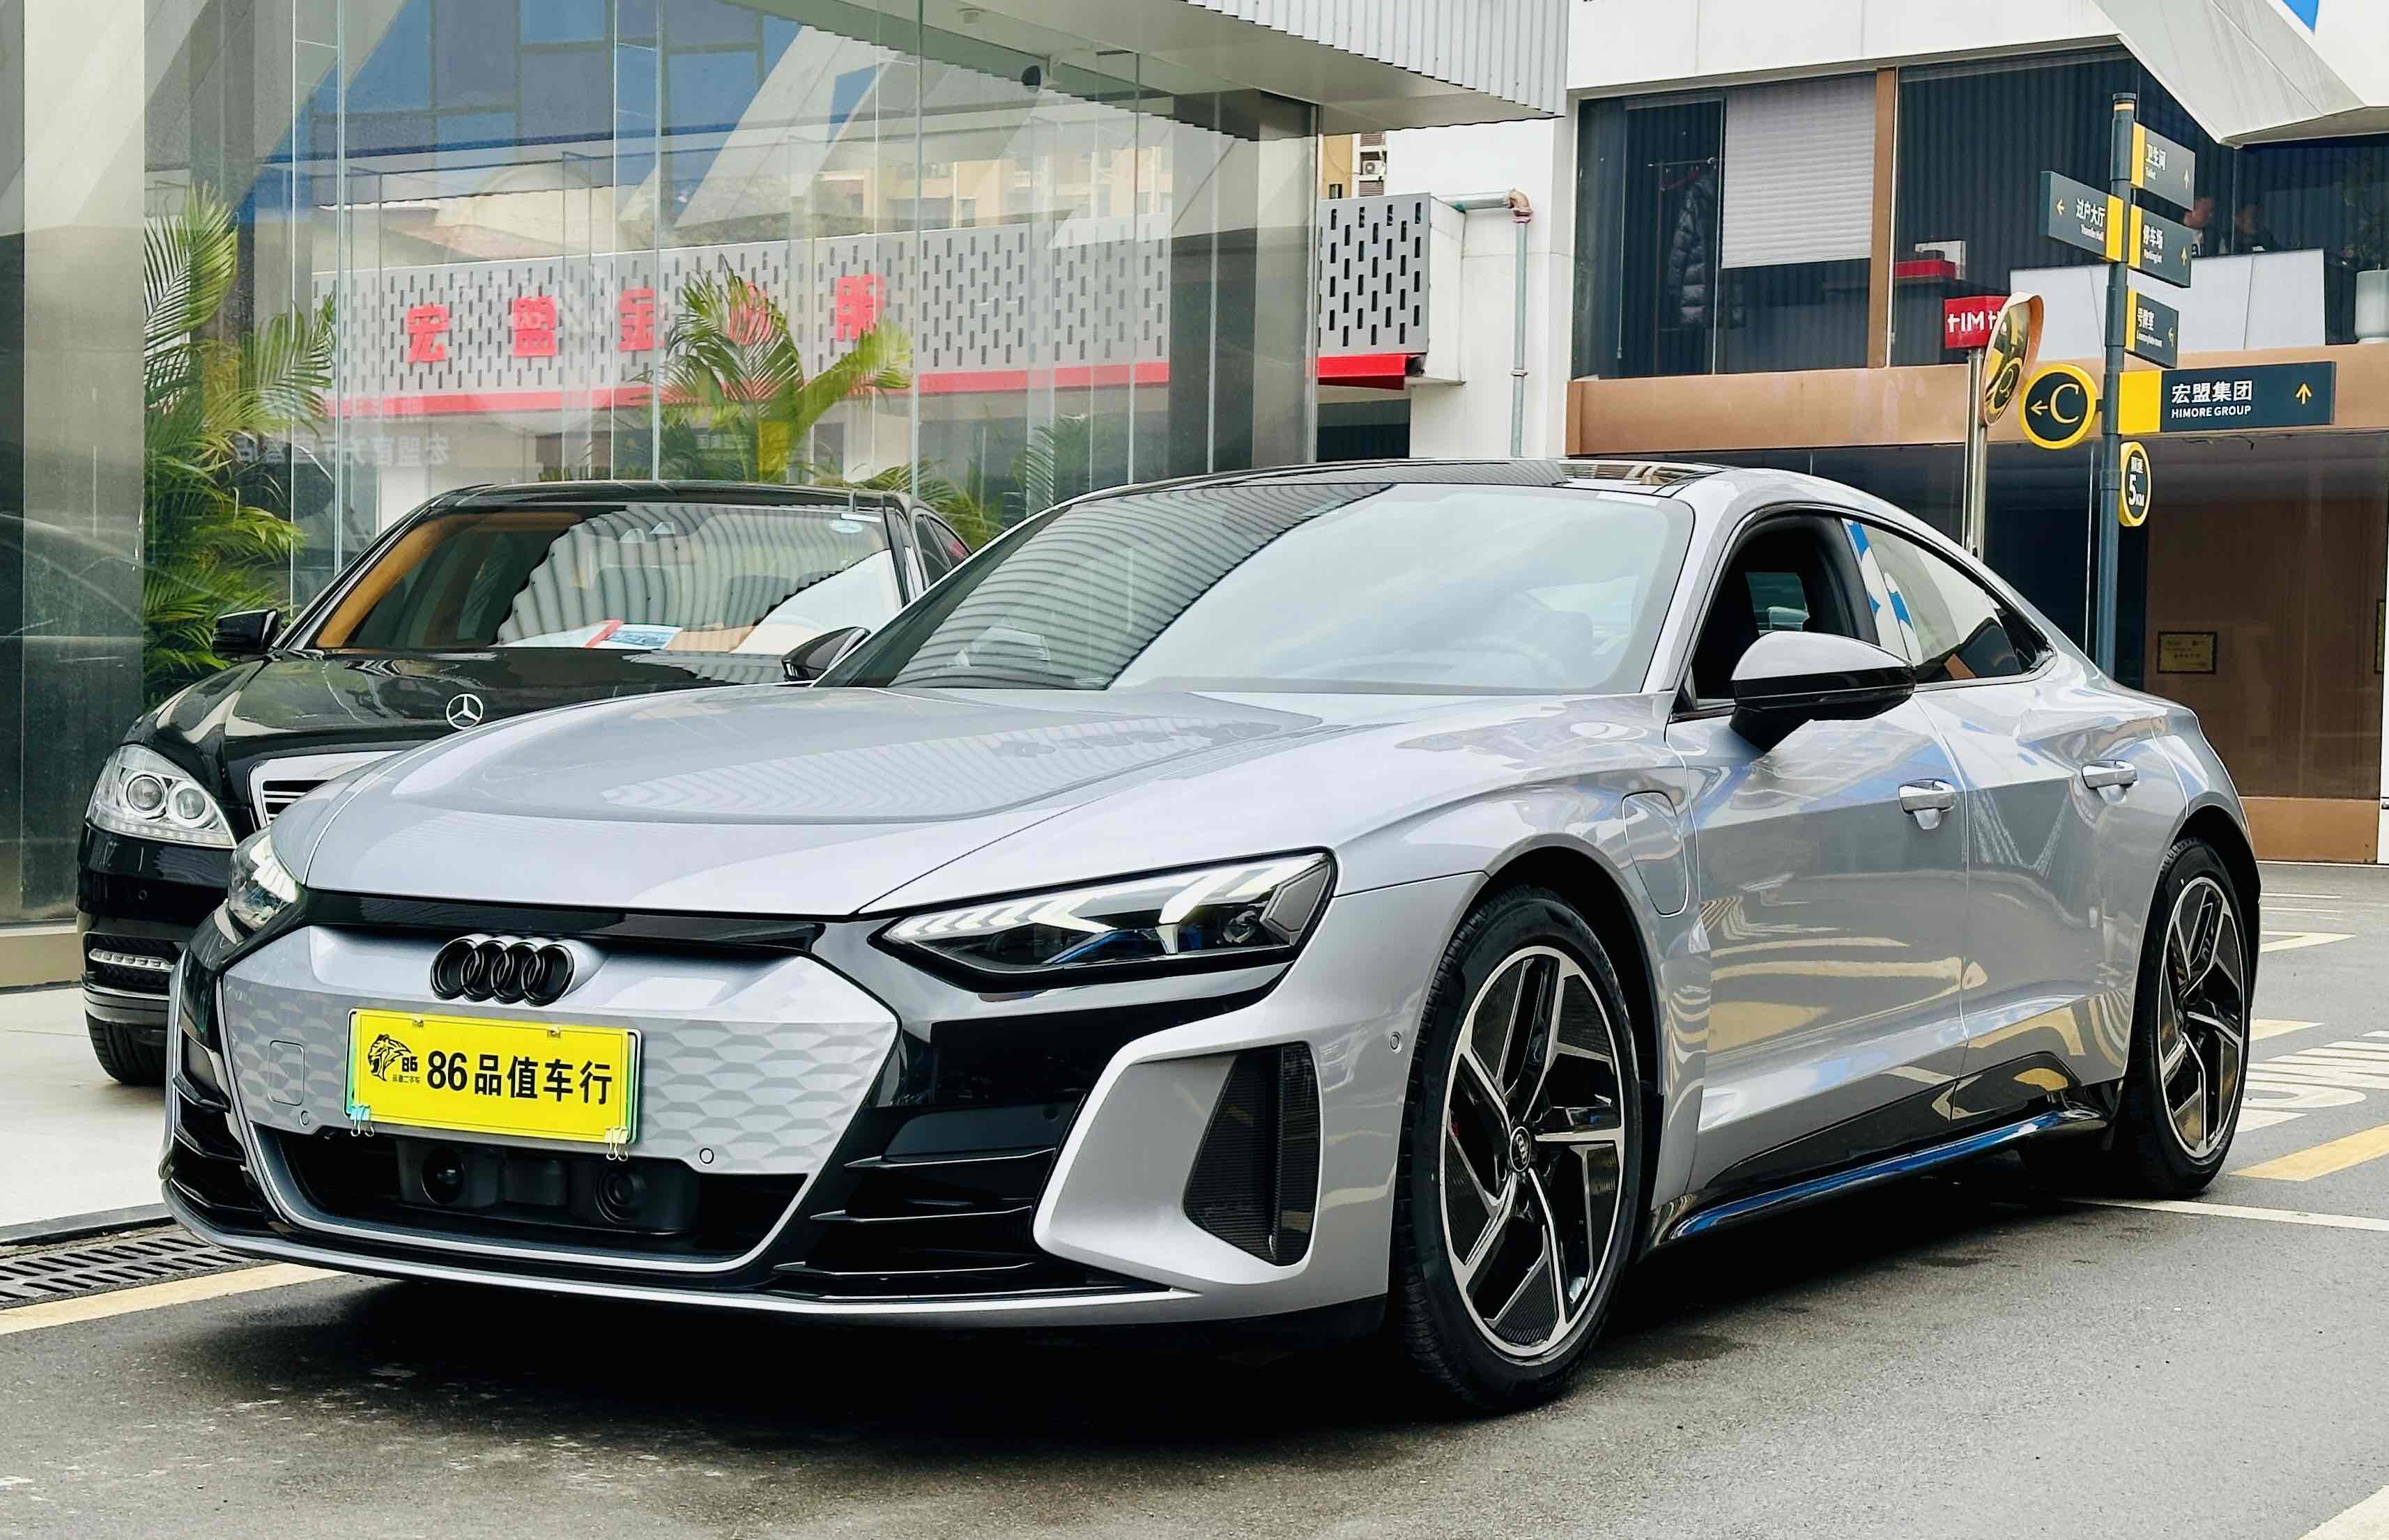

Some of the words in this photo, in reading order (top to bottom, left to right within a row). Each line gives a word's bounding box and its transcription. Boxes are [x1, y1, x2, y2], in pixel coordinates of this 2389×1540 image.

[2145, 144, 2166, 171] 卫生间
[2075, 197, 2106, 227] 过户大厅
[2050, 383, 2080, 424] C
[2171, 380, 2253, 404] 宏盟集团
[2171, 407, 2212, 419] HIMORE
[2213, 405, 2252, 417] GROUP
[401, 1056, 418, 1072] 86
